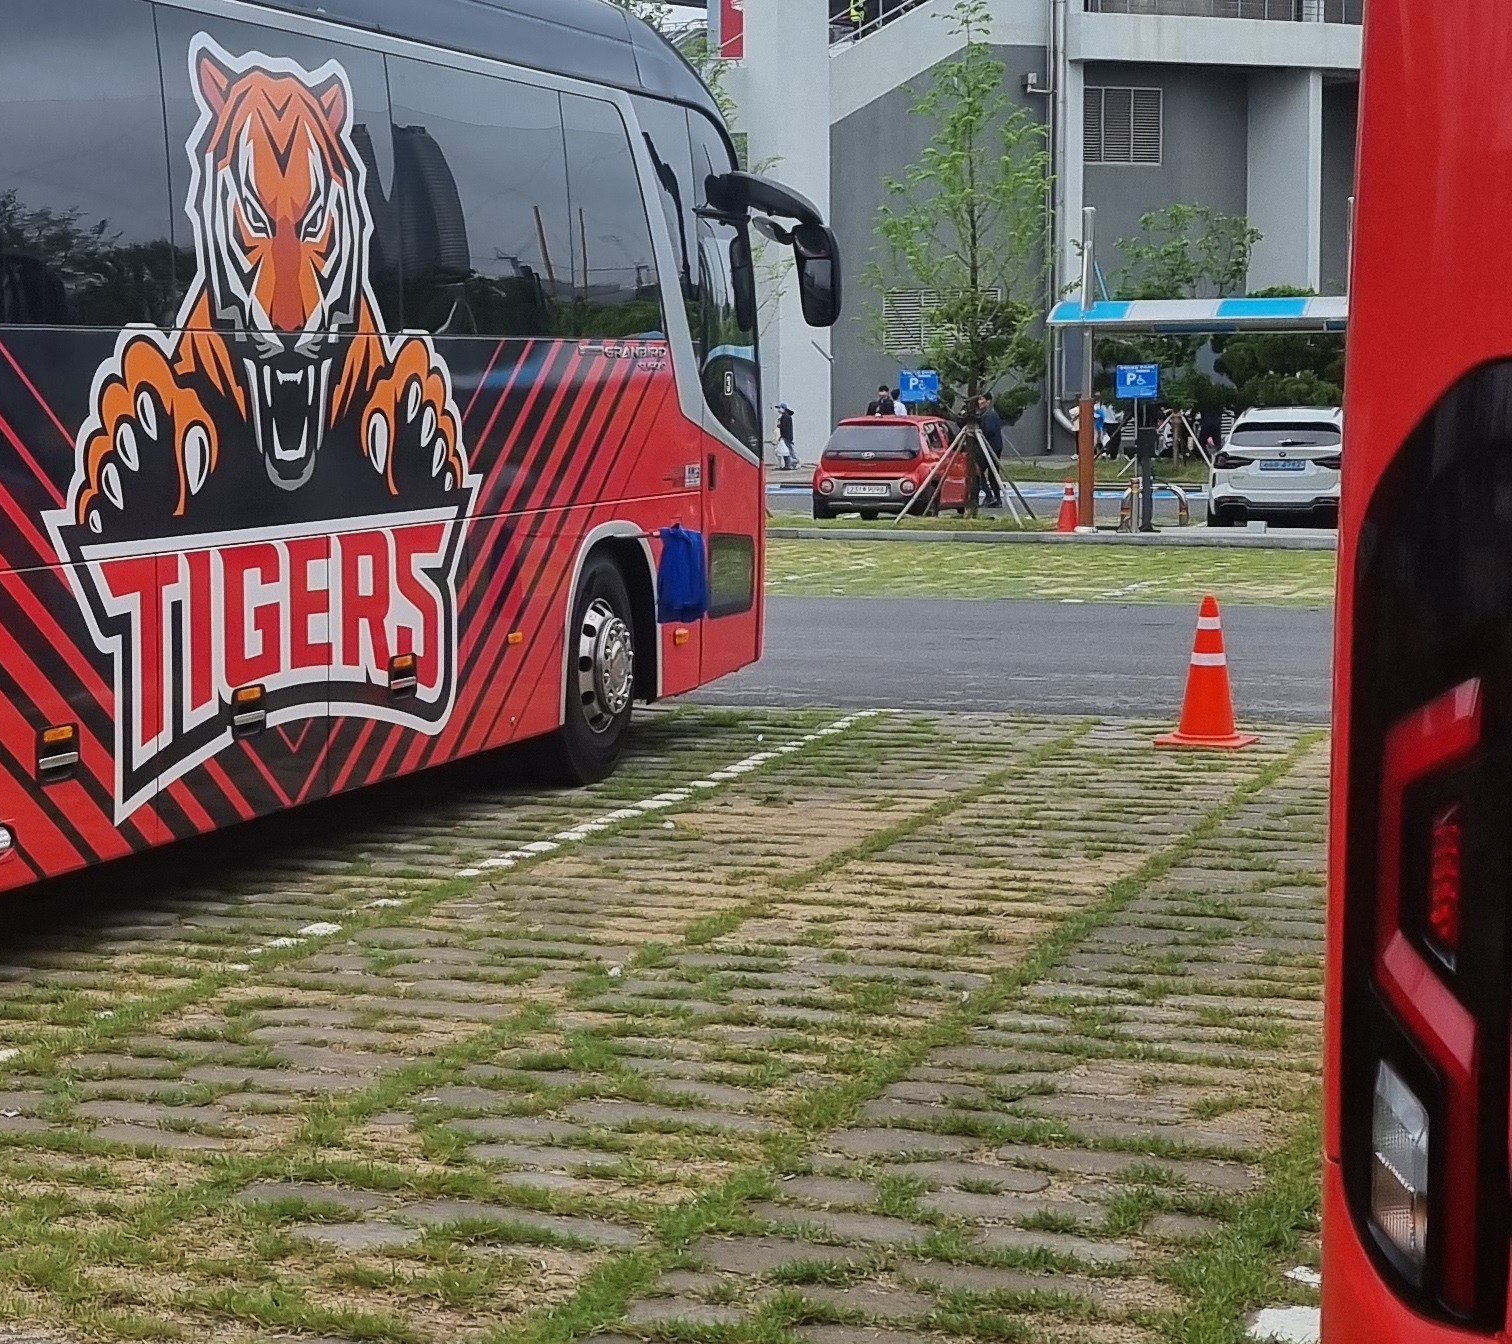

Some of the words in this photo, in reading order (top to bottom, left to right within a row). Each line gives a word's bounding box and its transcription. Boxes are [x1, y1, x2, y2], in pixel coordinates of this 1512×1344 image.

[604, 345, 667, 358] GRANBIRD
[1126, 373, 1136, 386] P
[94, 518, 452, 752] TIGERS
